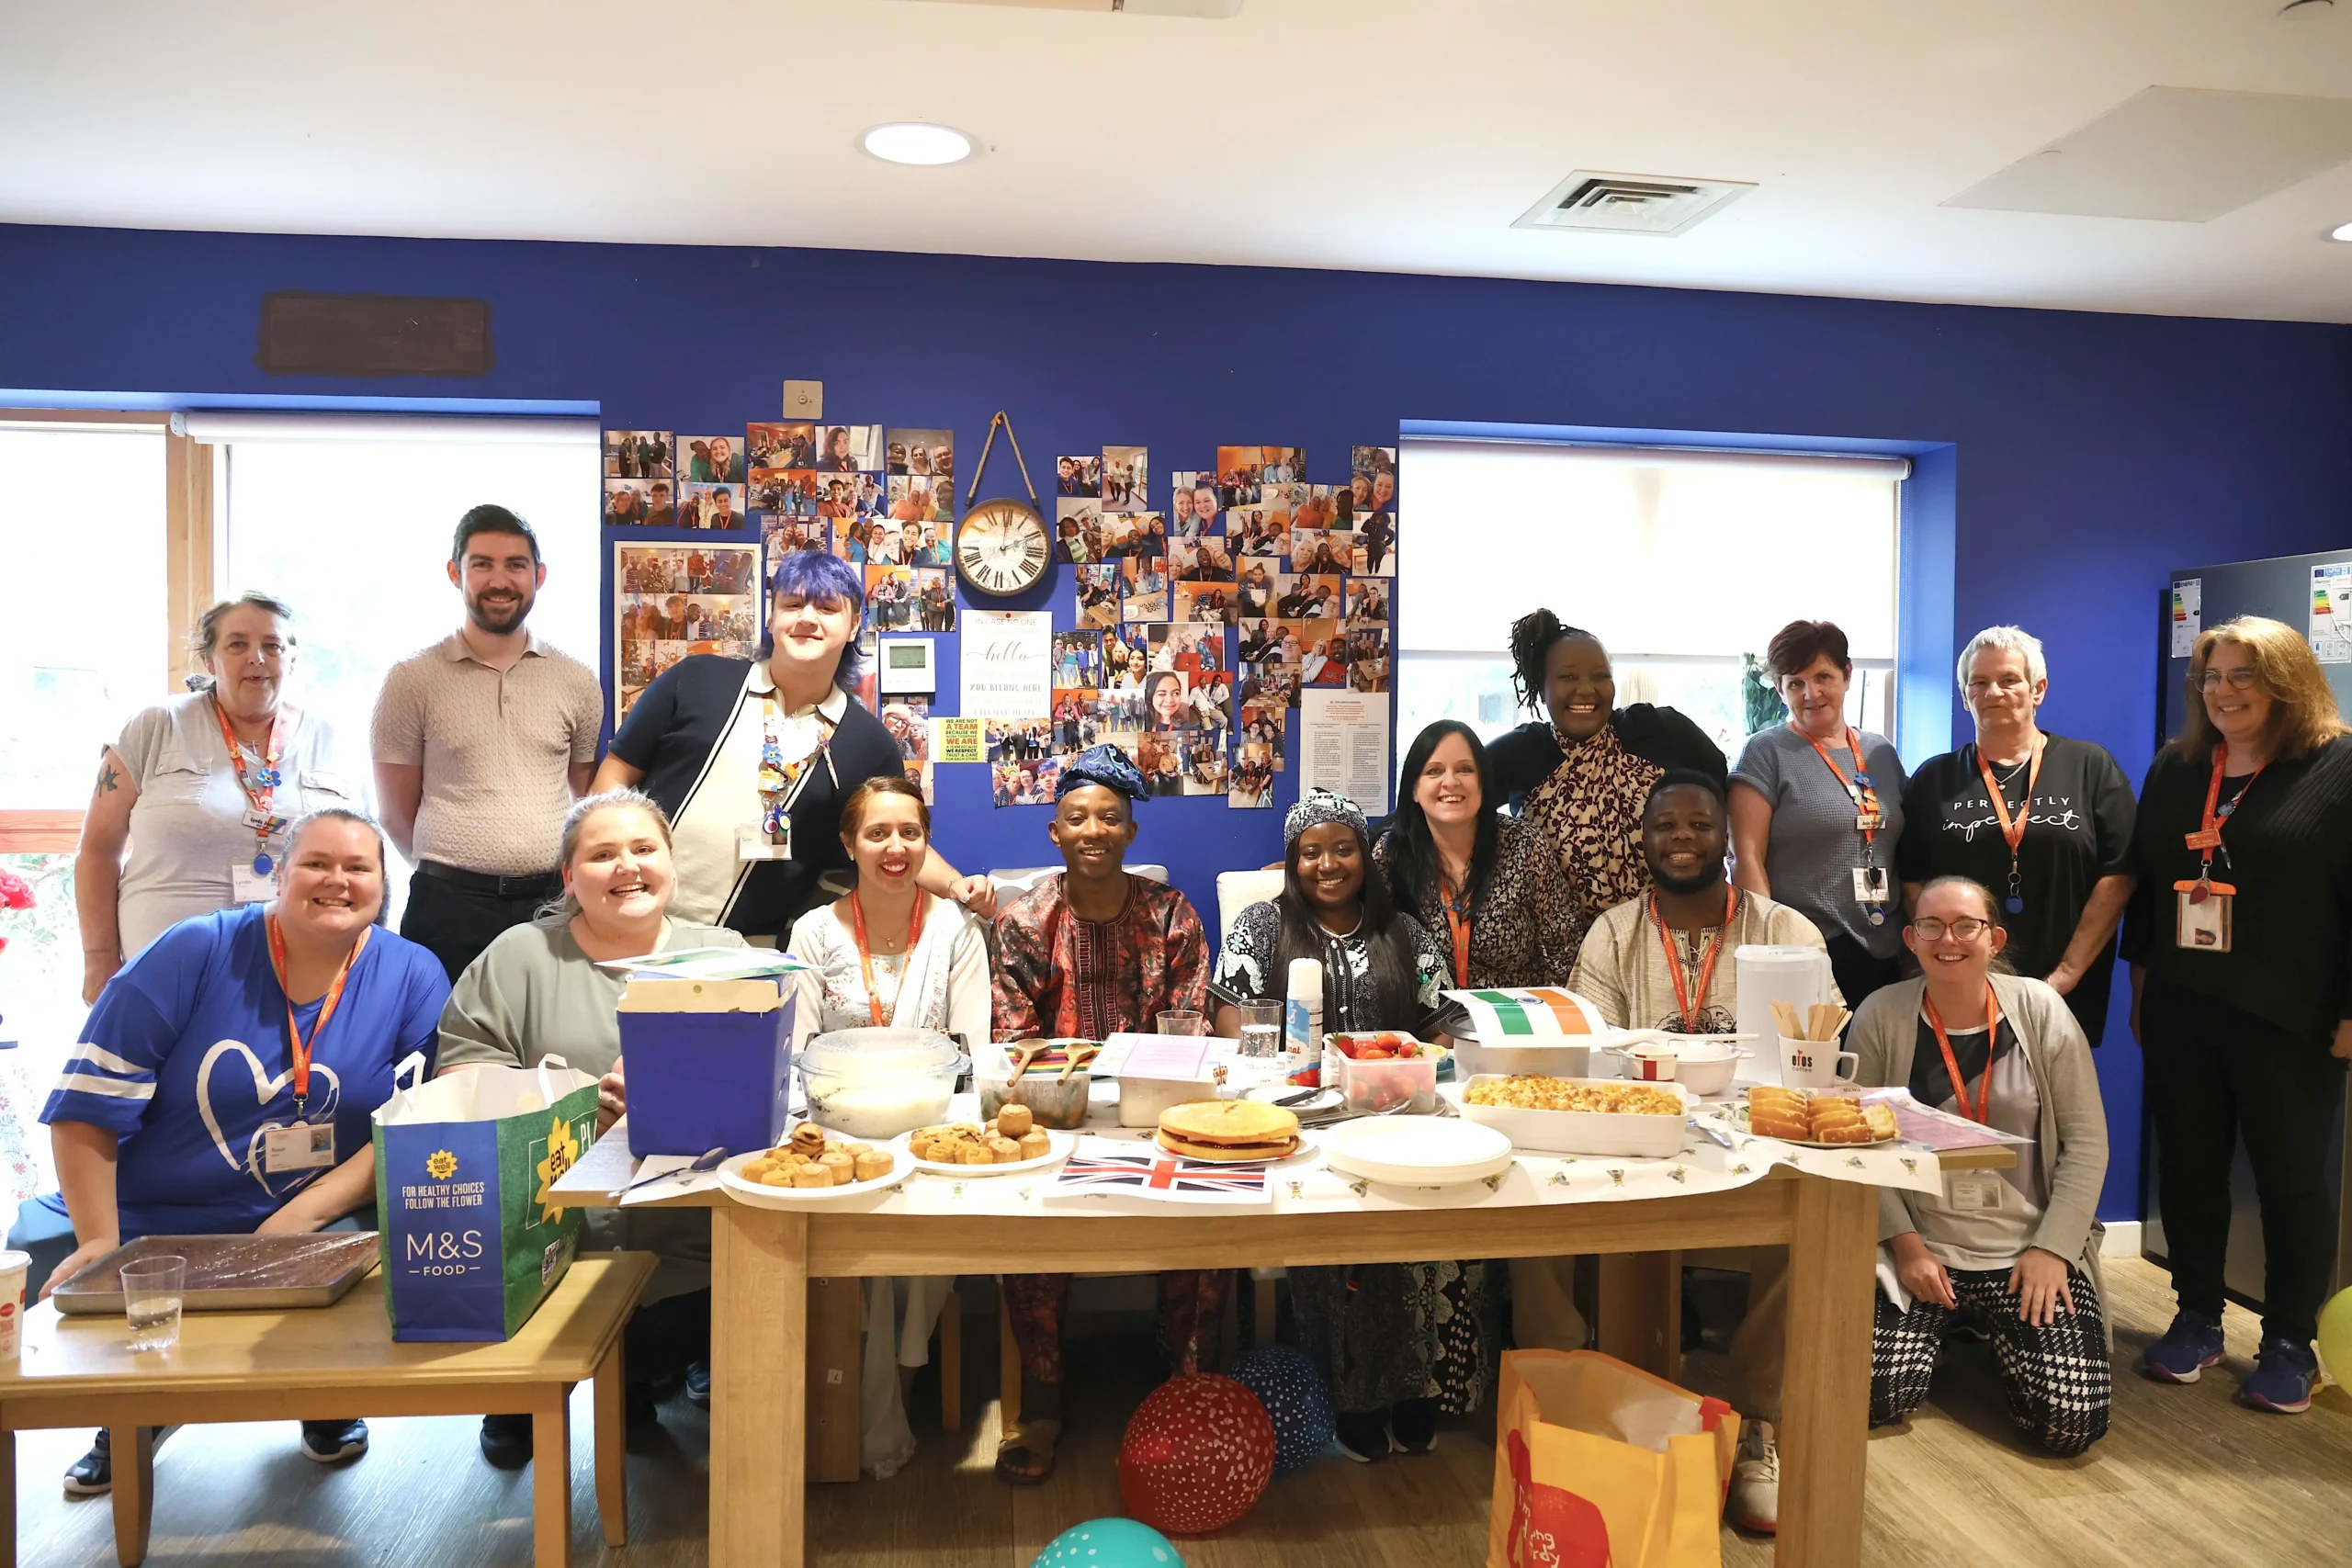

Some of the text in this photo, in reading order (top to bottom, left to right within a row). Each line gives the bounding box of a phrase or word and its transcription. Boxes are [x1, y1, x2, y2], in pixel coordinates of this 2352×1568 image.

[990, 684, 1019, 692] BELONG
[1954, 796, 2070, 810] PERECTLY
[1943, 809, 2080, 843] impeect
[580, 1118, 598, 1154] PL
[433, 1156, 447, 1164] eat
[551, 1141, 565, 1172] eat
[434, 1162, 451, 1170] well
[402, 1182, 485, 1197] FOR HEALTHY CHOICES
[405, 1194, 482, 1209] FOLLOW THE FLOWER
[407, 1230, 483, 1261] M&S
[423, 1265, 465, 1276] FOOD
